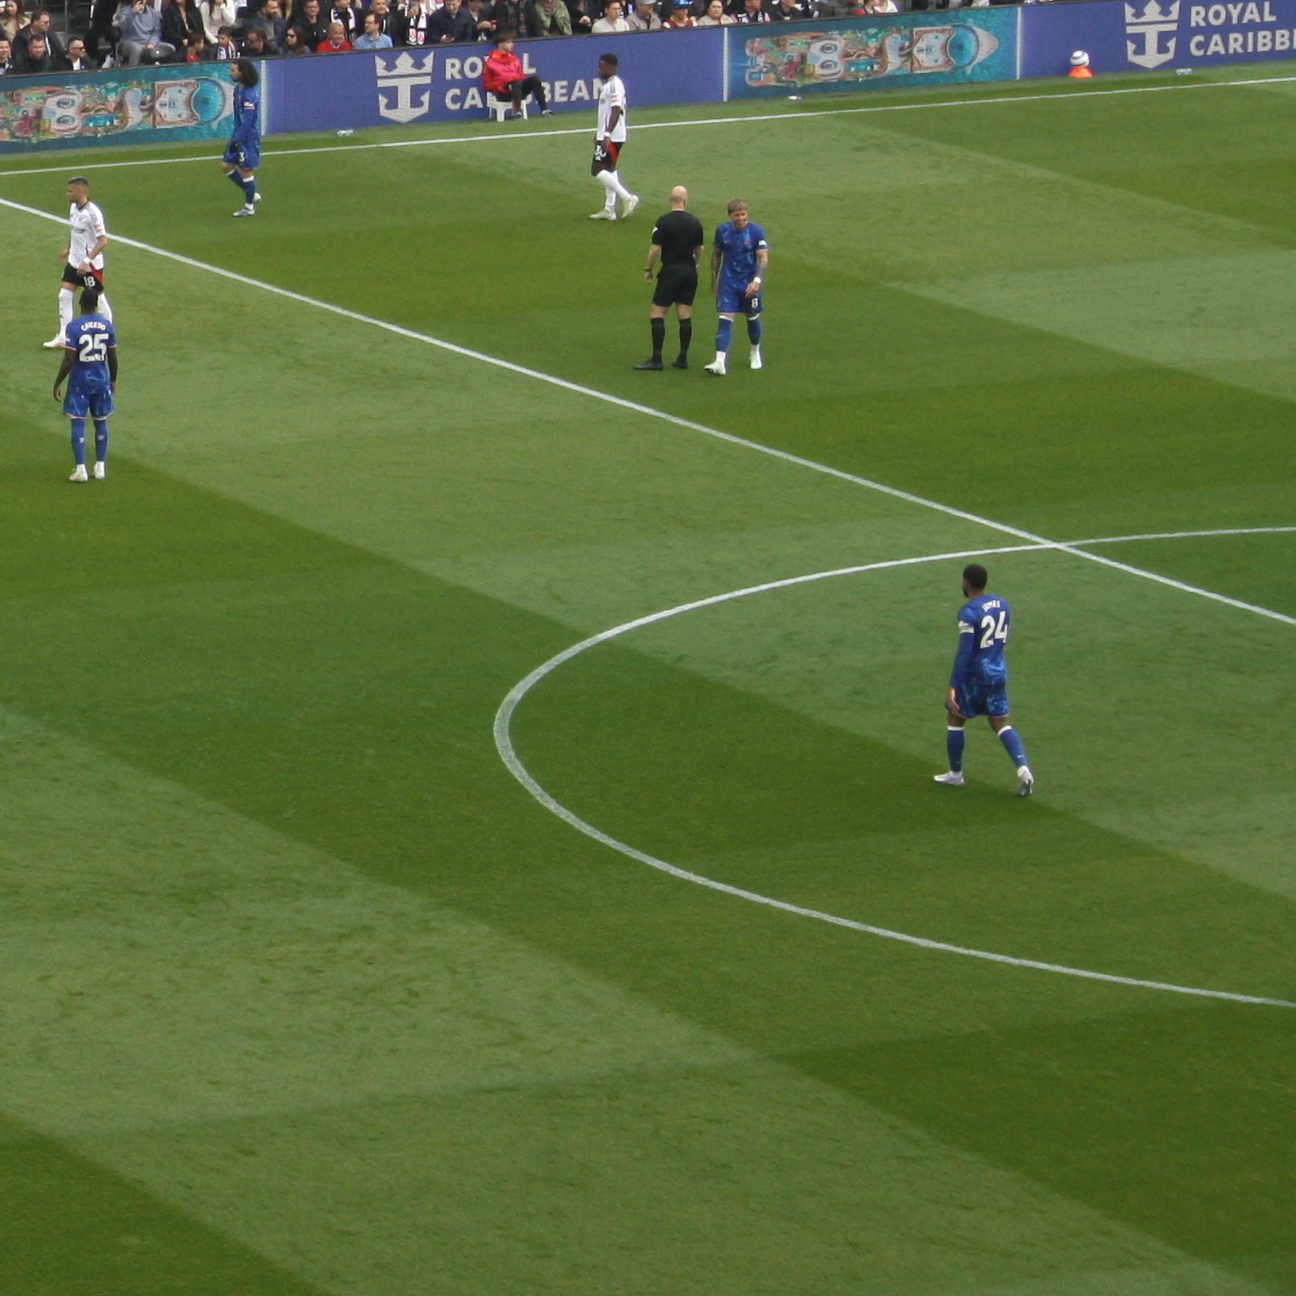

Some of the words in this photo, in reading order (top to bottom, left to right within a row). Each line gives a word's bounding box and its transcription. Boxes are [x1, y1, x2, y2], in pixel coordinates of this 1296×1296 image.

[1190, 0, 1277, 27] ROYAL
[78, 333, 110, 363] 25
[979, 610, 1008, 650] 24
